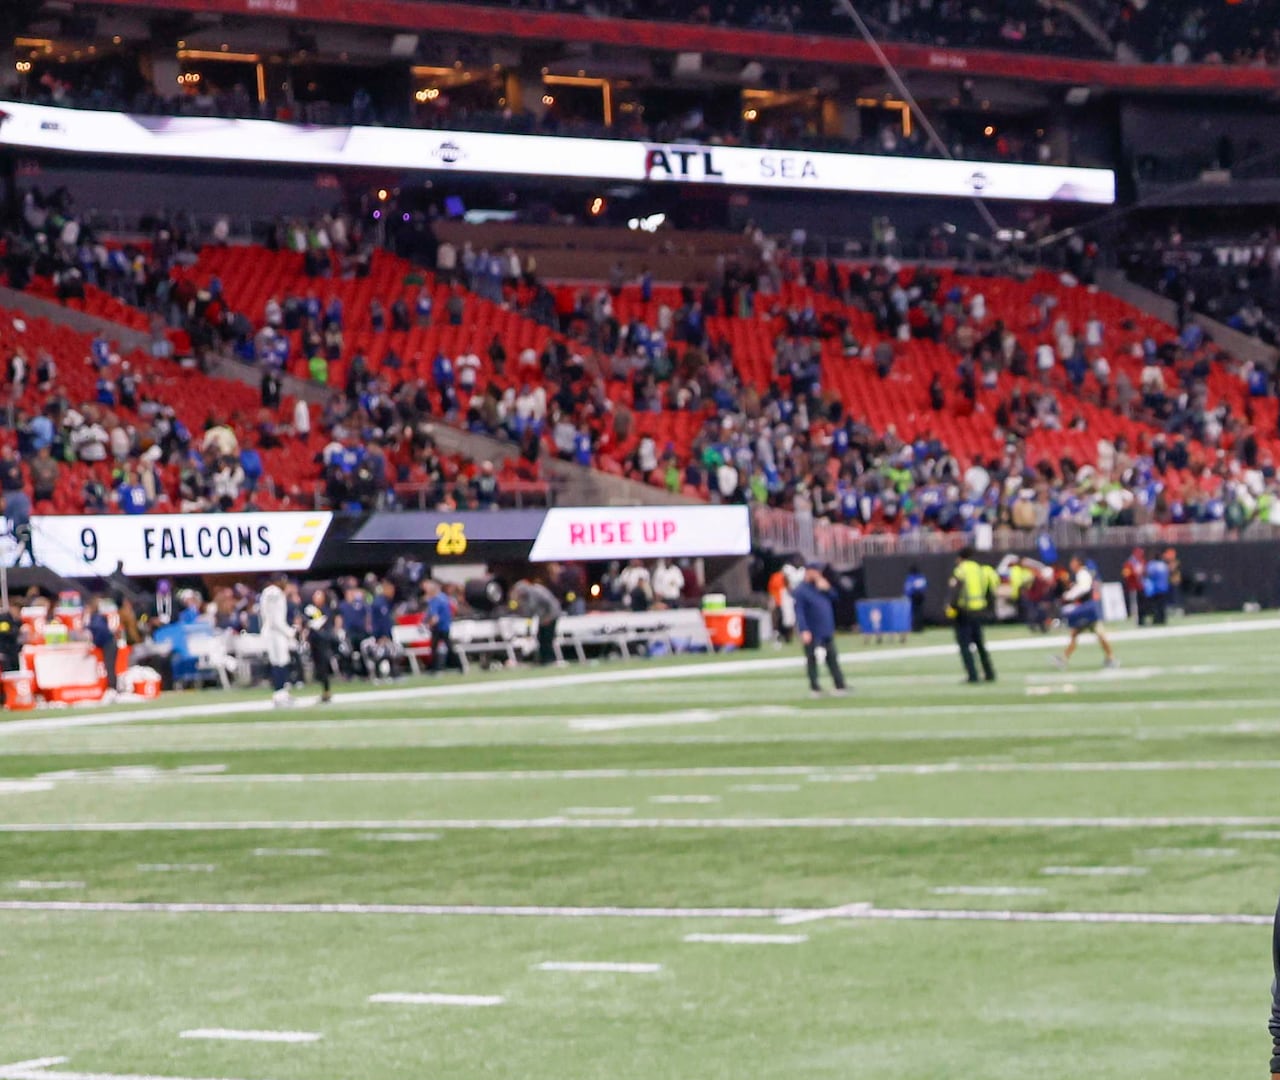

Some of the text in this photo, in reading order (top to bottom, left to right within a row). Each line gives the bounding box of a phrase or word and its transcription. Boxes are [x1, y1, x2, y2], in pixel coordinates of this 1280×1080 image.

[644, 148, 723, 178] ATL
[759, 155, 820, 180] SEA
[80, 526, 271, 562] 9 FALCONS
[435, 522, 467, 555] 25
[570, 521, 678, 545] RISE UP
